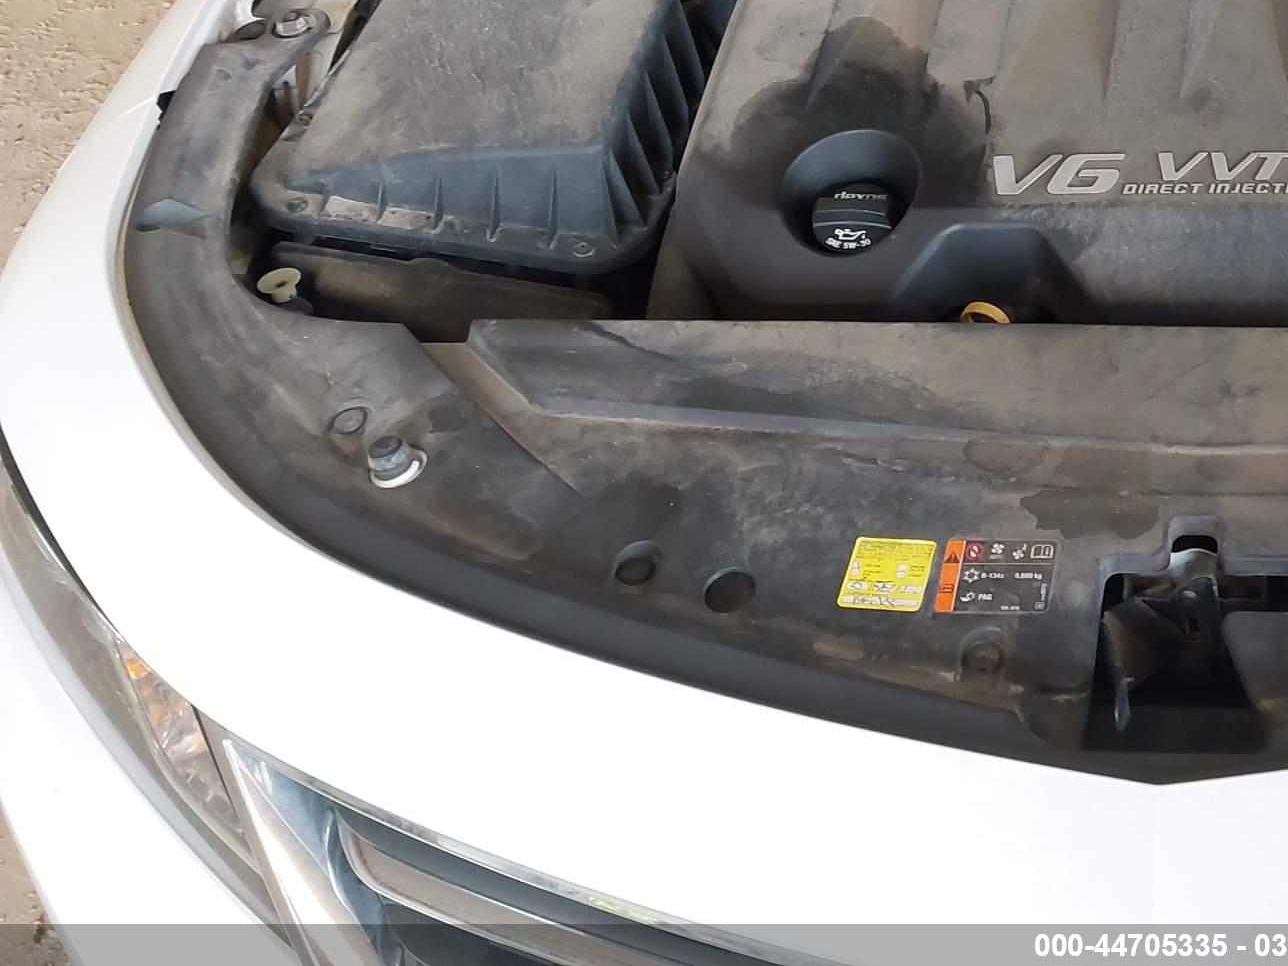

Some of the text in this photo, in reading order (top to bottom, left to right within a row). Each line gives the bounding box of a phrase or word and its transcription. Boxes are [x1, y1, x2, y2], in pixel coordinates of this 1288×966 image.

[993, 154, 1125, 195] V6
[1122, 183, 1203, 195] DIRECT
[843, 238, 872, 249] 5W-30
